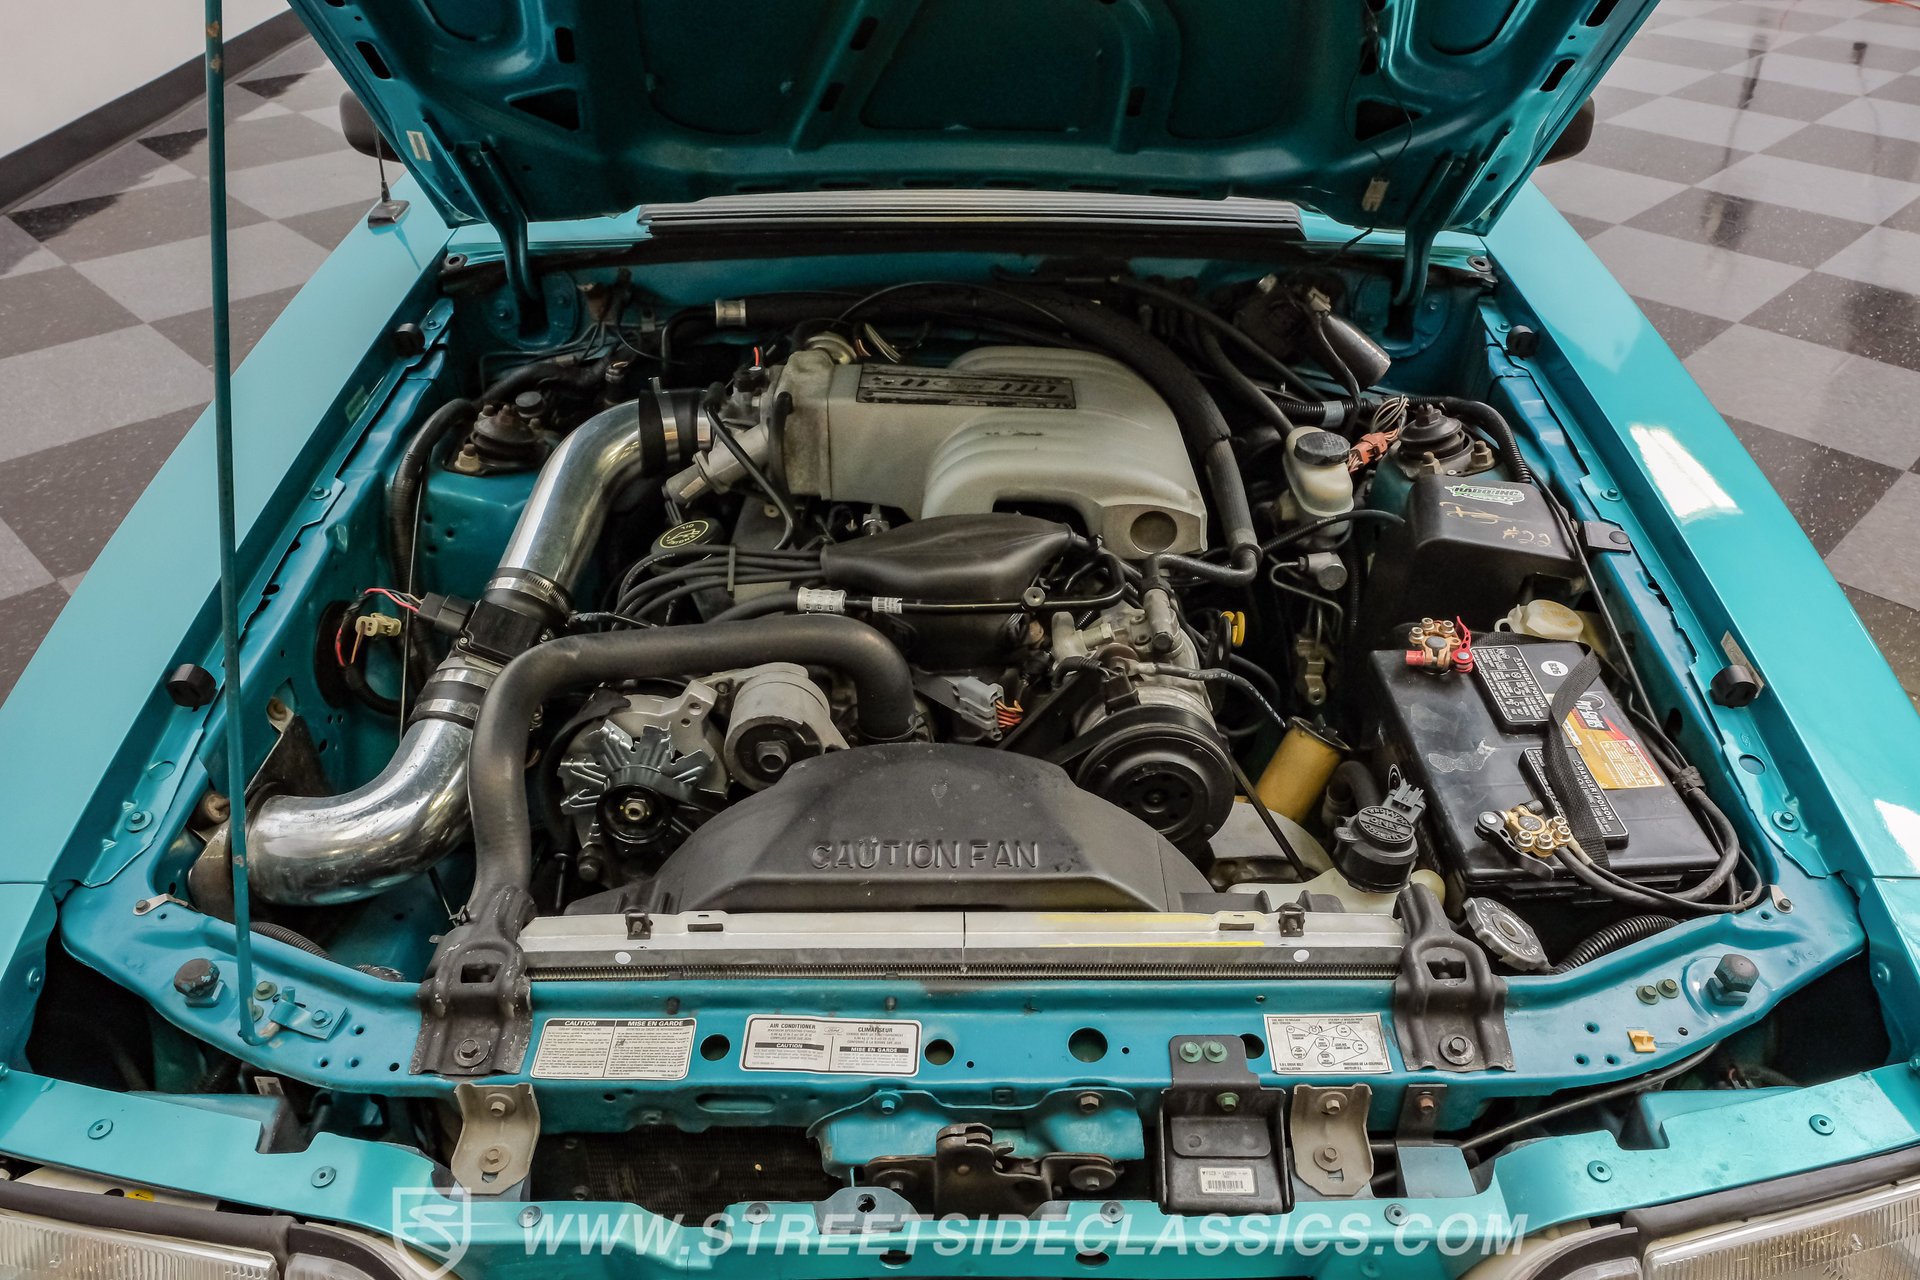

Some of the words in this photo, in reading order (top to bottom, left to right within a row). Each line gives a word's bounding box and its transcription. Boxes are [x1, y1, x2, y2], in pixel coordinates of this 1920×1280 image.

[1517, 661, 1548, 709] DANGER/POISON
[1577, 765, 1615, 822] DANGER/POISON
[1369, 817, 1401, 831] ONLY
[812, 839, 960, 869] CAUTION
[969, 839, 1039, 869] FAN
